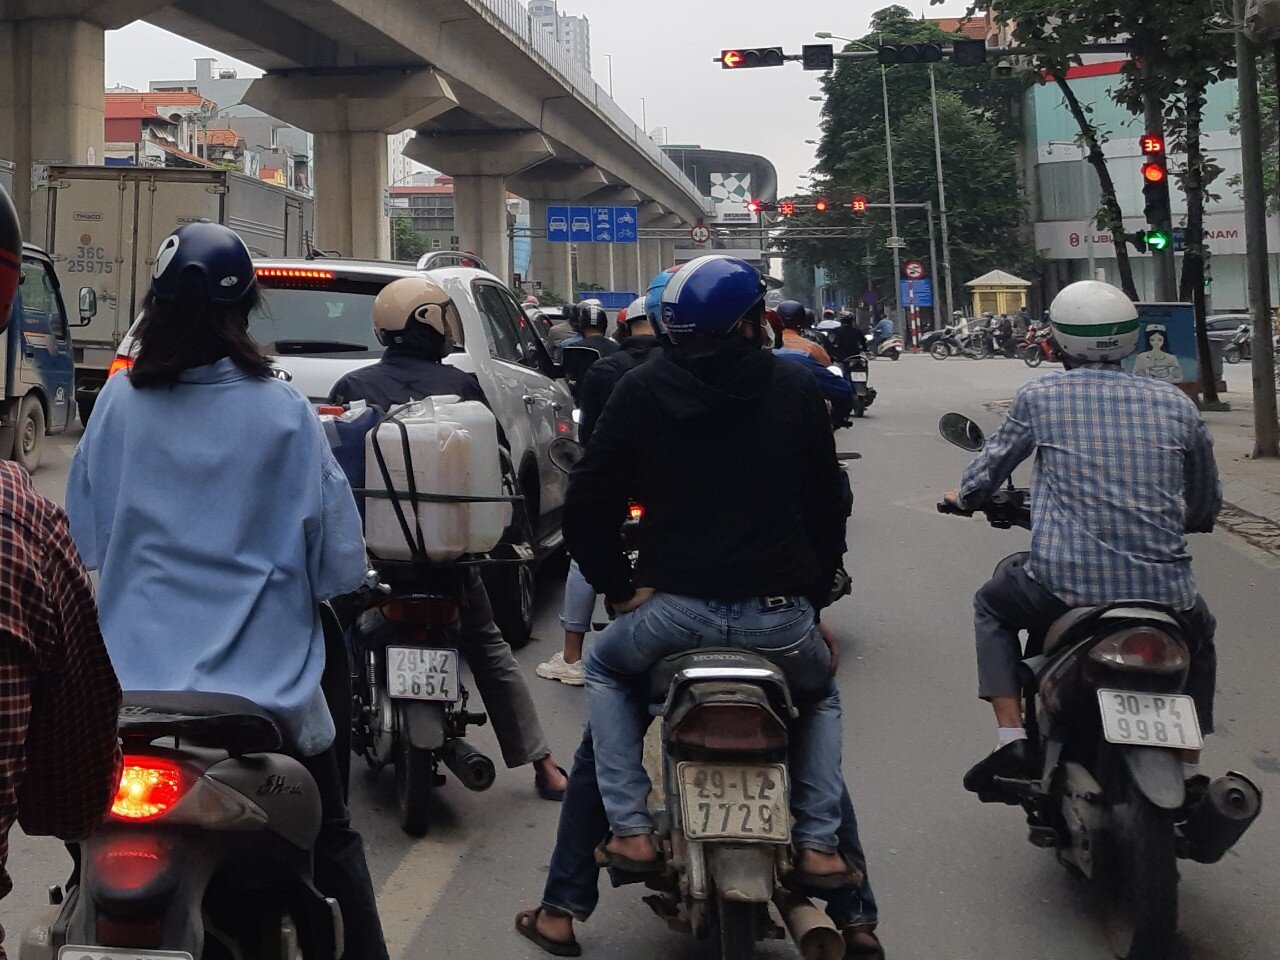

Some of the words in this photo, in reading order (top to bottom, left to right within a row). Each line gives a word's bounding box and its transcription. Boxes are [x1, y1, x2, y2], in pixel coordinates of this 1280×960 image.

[77, 247, 104, 259] 36C
[68, 260, 113, 273] 259.75
[397, 673, 449, 697] 3654
[1113, 694, 1181, 720] 30-P4
[1118, 718, 1186, 744] 9981
[698, 803, 772, 834] 7729
